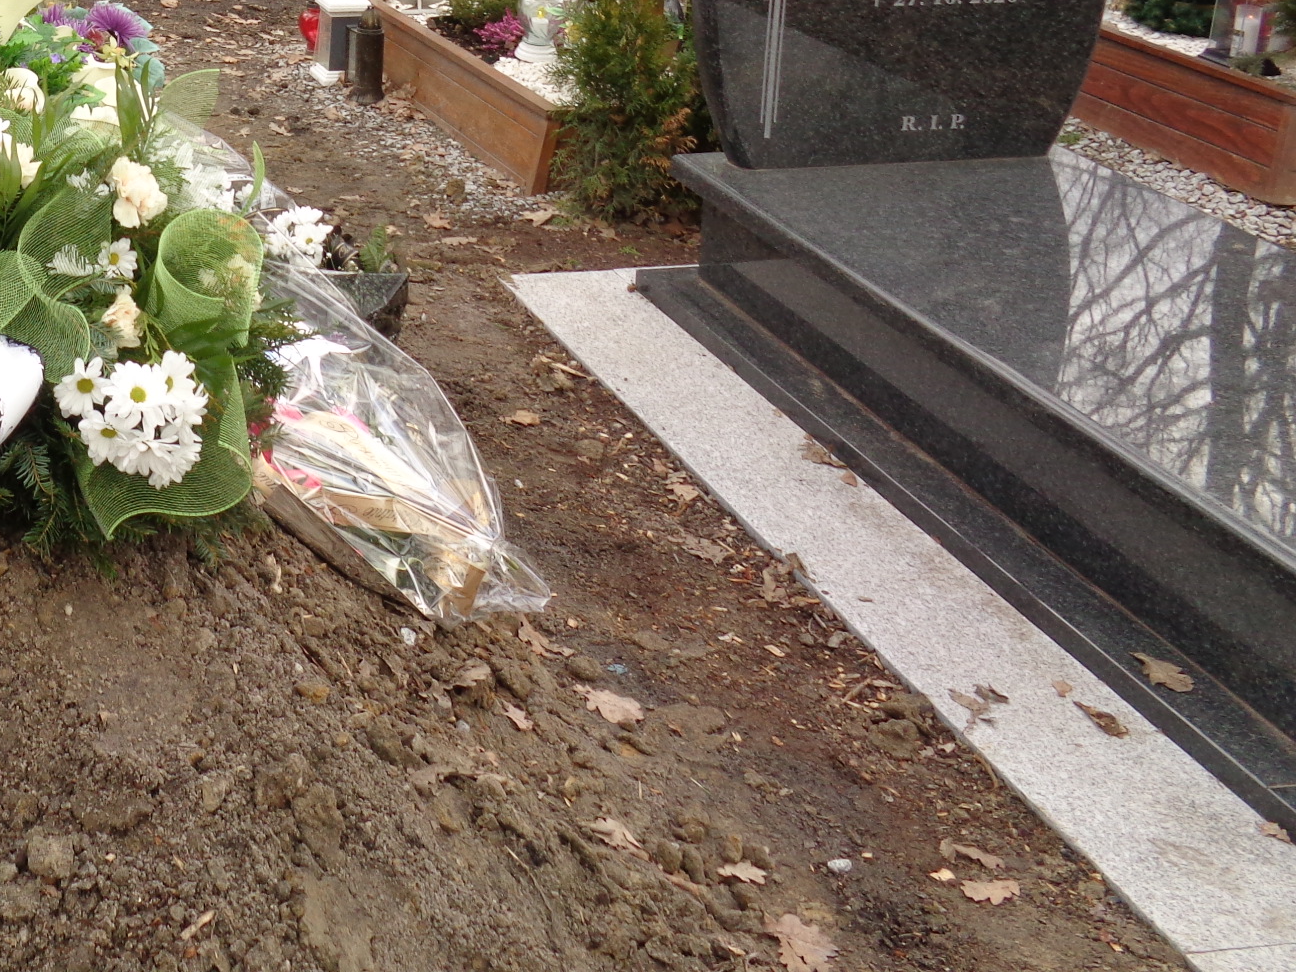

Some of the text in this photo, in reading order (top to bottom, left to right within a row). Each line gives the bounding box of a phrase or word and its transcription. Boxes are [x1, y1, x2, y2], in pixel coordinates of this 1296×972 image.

[900, 114, 966, 132] R. I. P.
